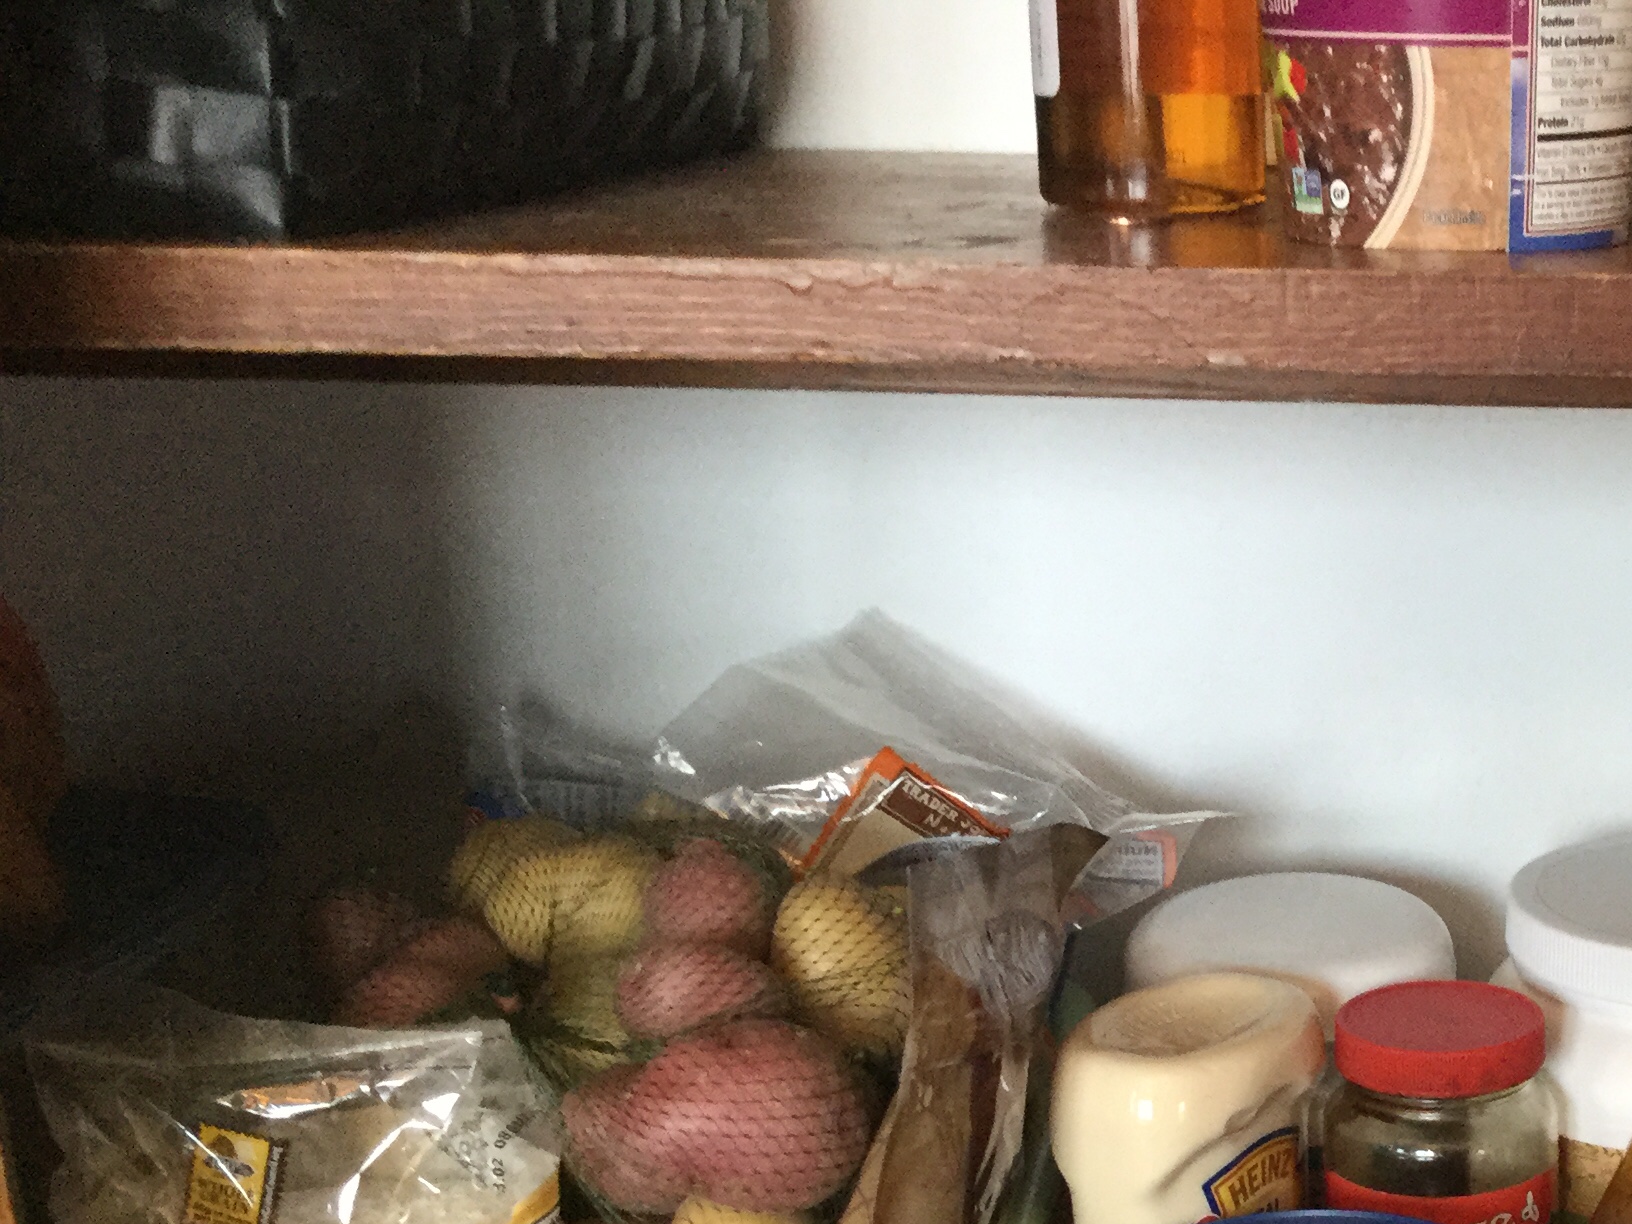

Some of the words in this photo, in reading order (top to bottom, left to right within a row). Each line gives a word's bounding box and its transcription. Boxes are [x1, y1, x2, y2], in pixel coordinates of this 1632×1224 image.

[1537, 117, 1568, 129] Protein
[901, 779, 959, 822] TRADER
[1227, 1146, 1297, 1212] HEINZ
